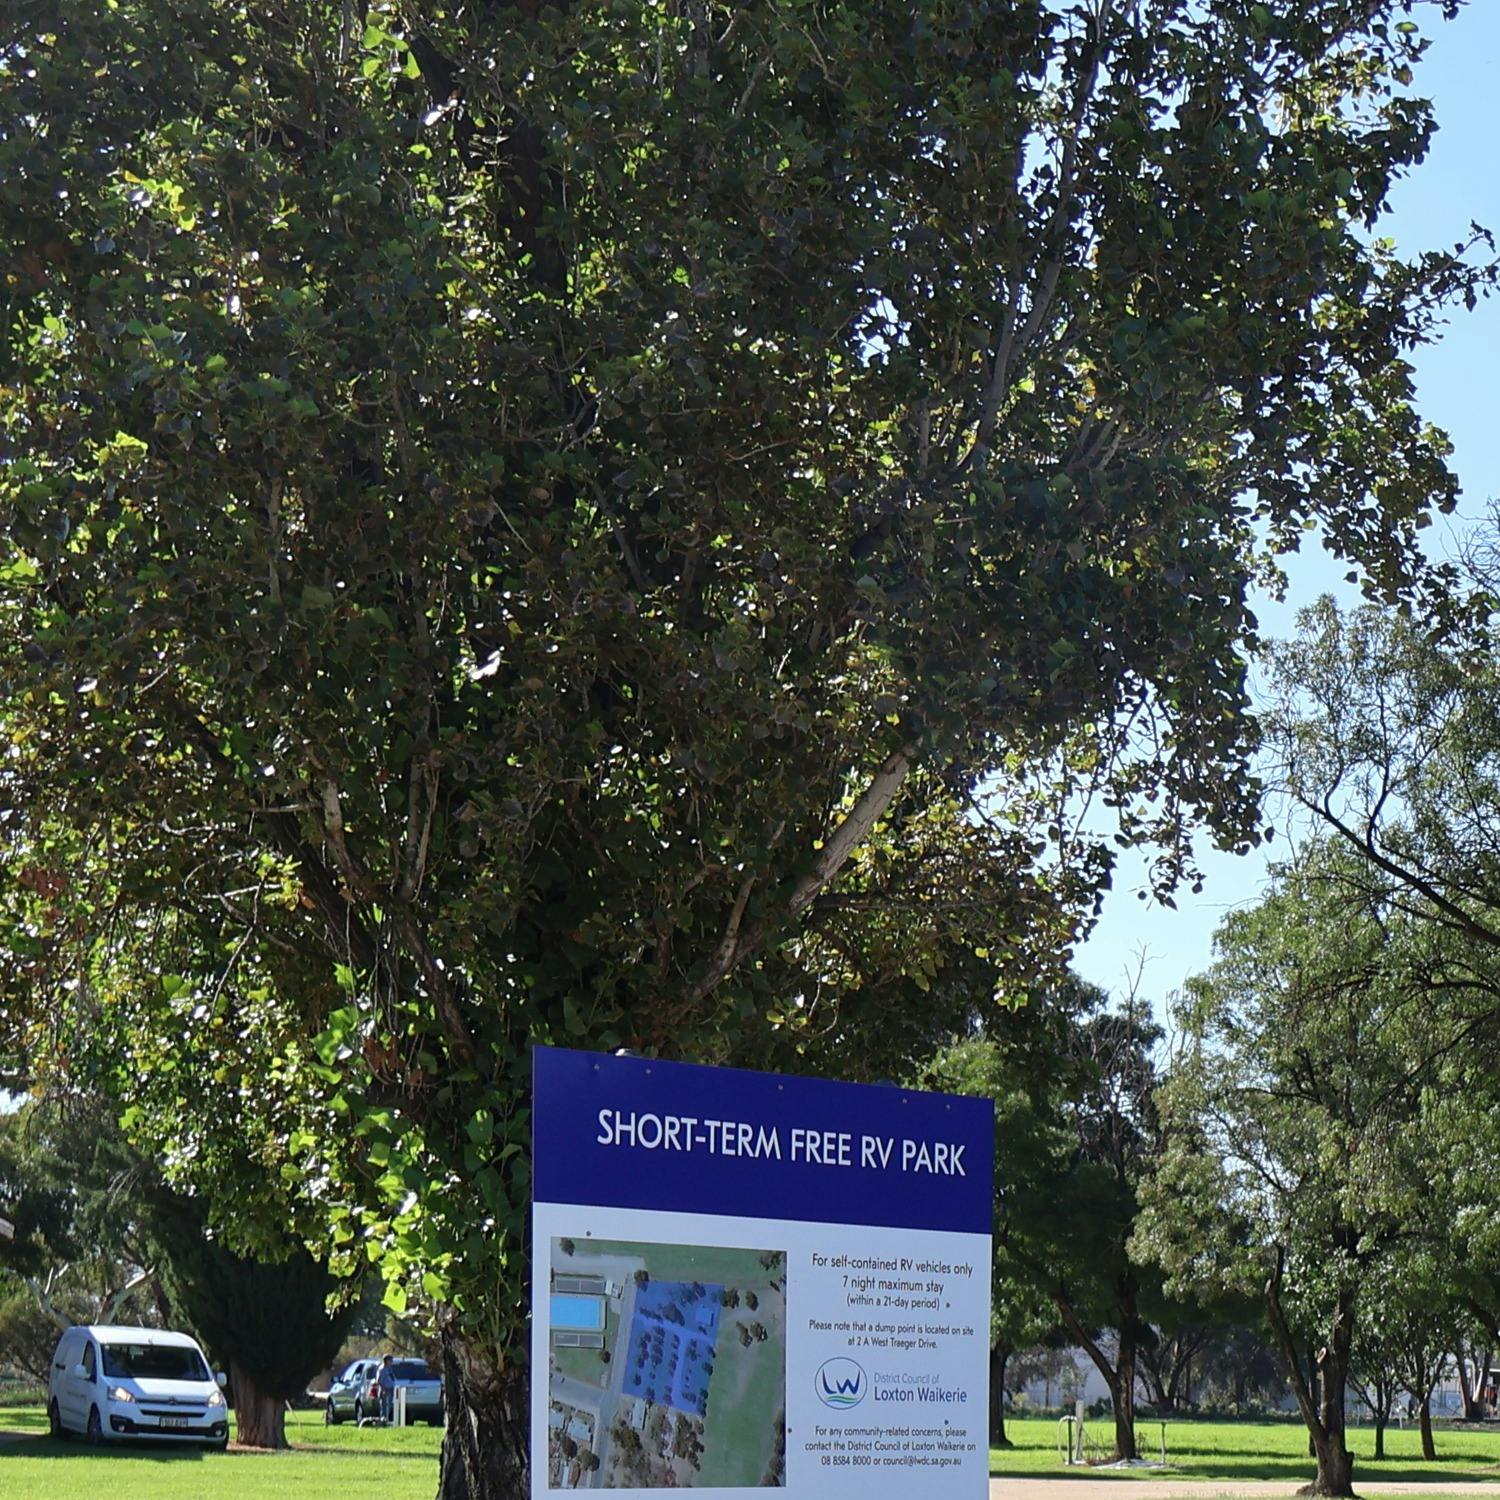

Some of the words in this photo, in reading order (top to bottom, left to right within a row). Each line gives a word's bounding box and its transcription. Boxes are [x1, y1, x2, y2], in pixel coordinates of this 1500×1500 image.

[597, 1108, 781, 1160] SHORT-TERM
[791, 1128, 851, 1166] FREE
[861, 1135, 893, 1169] RV
[902, 1139, 966, 1176] PARK
[812, 1253, 828, 1266] For
[831, 1255, 897, 1270] self-contained
[901, 1259, 914, 1271] RV
[916, 1260, 951, 1274] vehicles
[954, 1263, 973, 1277] only
[843, 1276, 847, 1287] 7
[851, 1276, 875, 1291] night
[878, 1278, 923, 1291] maximum
[926, 1281, 944, 1295] stay
[847, 1293, 874, 1306] (within
[876, 1298, 881, 1306] a
[884, 1296, 908, 1310] 21-day
[911, 1297, 940, 1311] period)
[809, 1320, 832, 1330] Please
[834, 1321, 850, 1331] note
[852, 1321, 866, 1331] that
[875, 1322, 895, 1335] dump
[898, 1324, 916, 1335] point
[918, 1324, 923, 1333] is
[925, 1325, 949, 1335] located
[962, 1327, 974, 1336] site
[848, 1336, 855, 1346] at
[857, 1337, 861, 1346] 2
[863, 1338, 869, 1346] A
[871, 1338, 888, 1347] West
[891, 1339, 916, 1350] Traeger
[918, 1339, 938, 1349] Drive.
[874, 1373, 900, 1384] District
[902, 1374, 930, 1384] Council
[932, 1374, 940, 1384] of
[874, 1386, 914, 1401] Loxton
[918, 1387, 967, 1402] Waikerie
[815, 1425, 827, 1436] For
[830, 1428, 842, 1438] any
[844, 1427, 910, 1438] community-related
[911, 1429, 943, 1438] concerns,
[945, 1427, 966, 1438] please
[805, 1441, 832, 1450] contact
[834, 1441, 845, 1450] the
[847, 1441, 872, 1450] District
[874, 1441, 900, 1450] Council
[902, 1441, 910, 1450] of
[912, 1441, 935, 1450] Loxton
[937, 1441, 965, 1451] Waikerie
[821, 1456, 831, 1465] 08
[833, 1456, 850, 1465] 8584
[853, 1456, 871, 1465] 8000
[883, 1455, 961, 1468] council@lwdc.sa.gov.au
